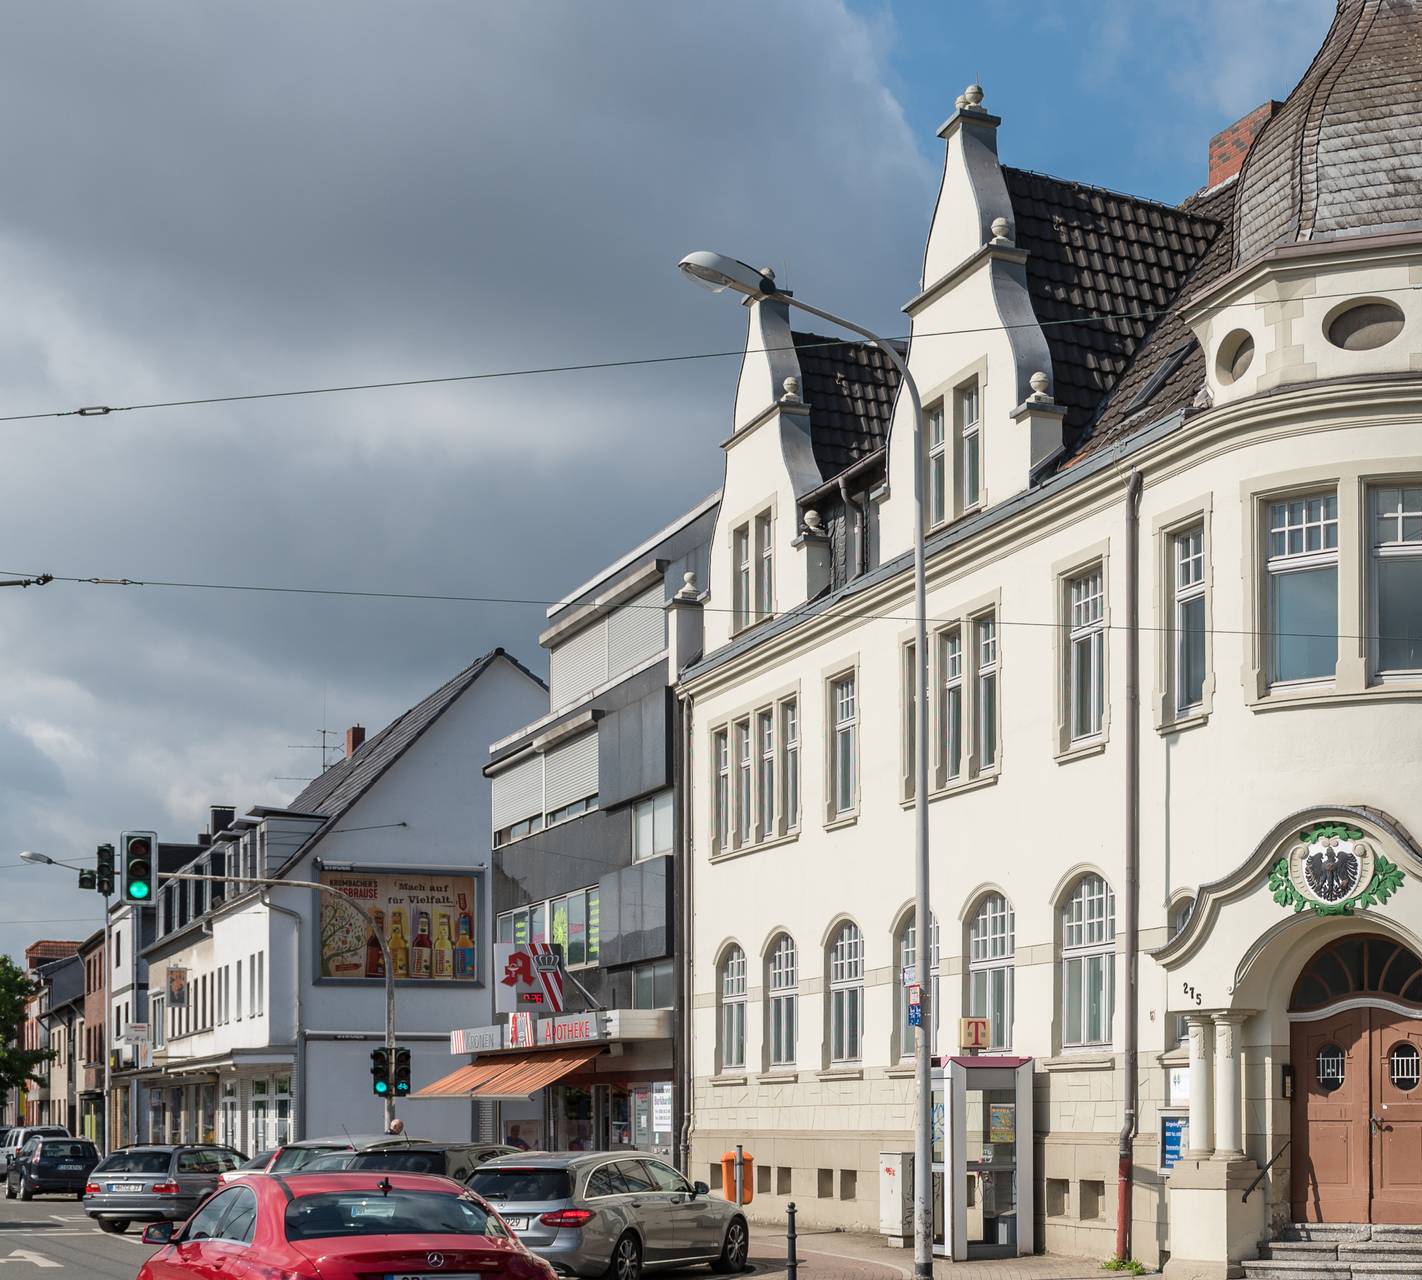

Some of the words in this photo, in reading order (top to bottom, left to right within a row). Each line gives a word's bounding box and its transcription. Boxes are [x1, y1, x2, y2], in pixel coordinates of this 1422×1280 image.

[330, 887, 378, 898] SBRAUSE
[399, 883, 425, 891] Mach
[429, 884, 448, 892] auf
[388, 896, 404, 904] für
[408, 895, 453, 904] Vielfalt.
[1183, 982, 1202, 1006] 275
[465, 1031, 494, 1049] KRONEN
[968, 1021, 986, 1045] T
